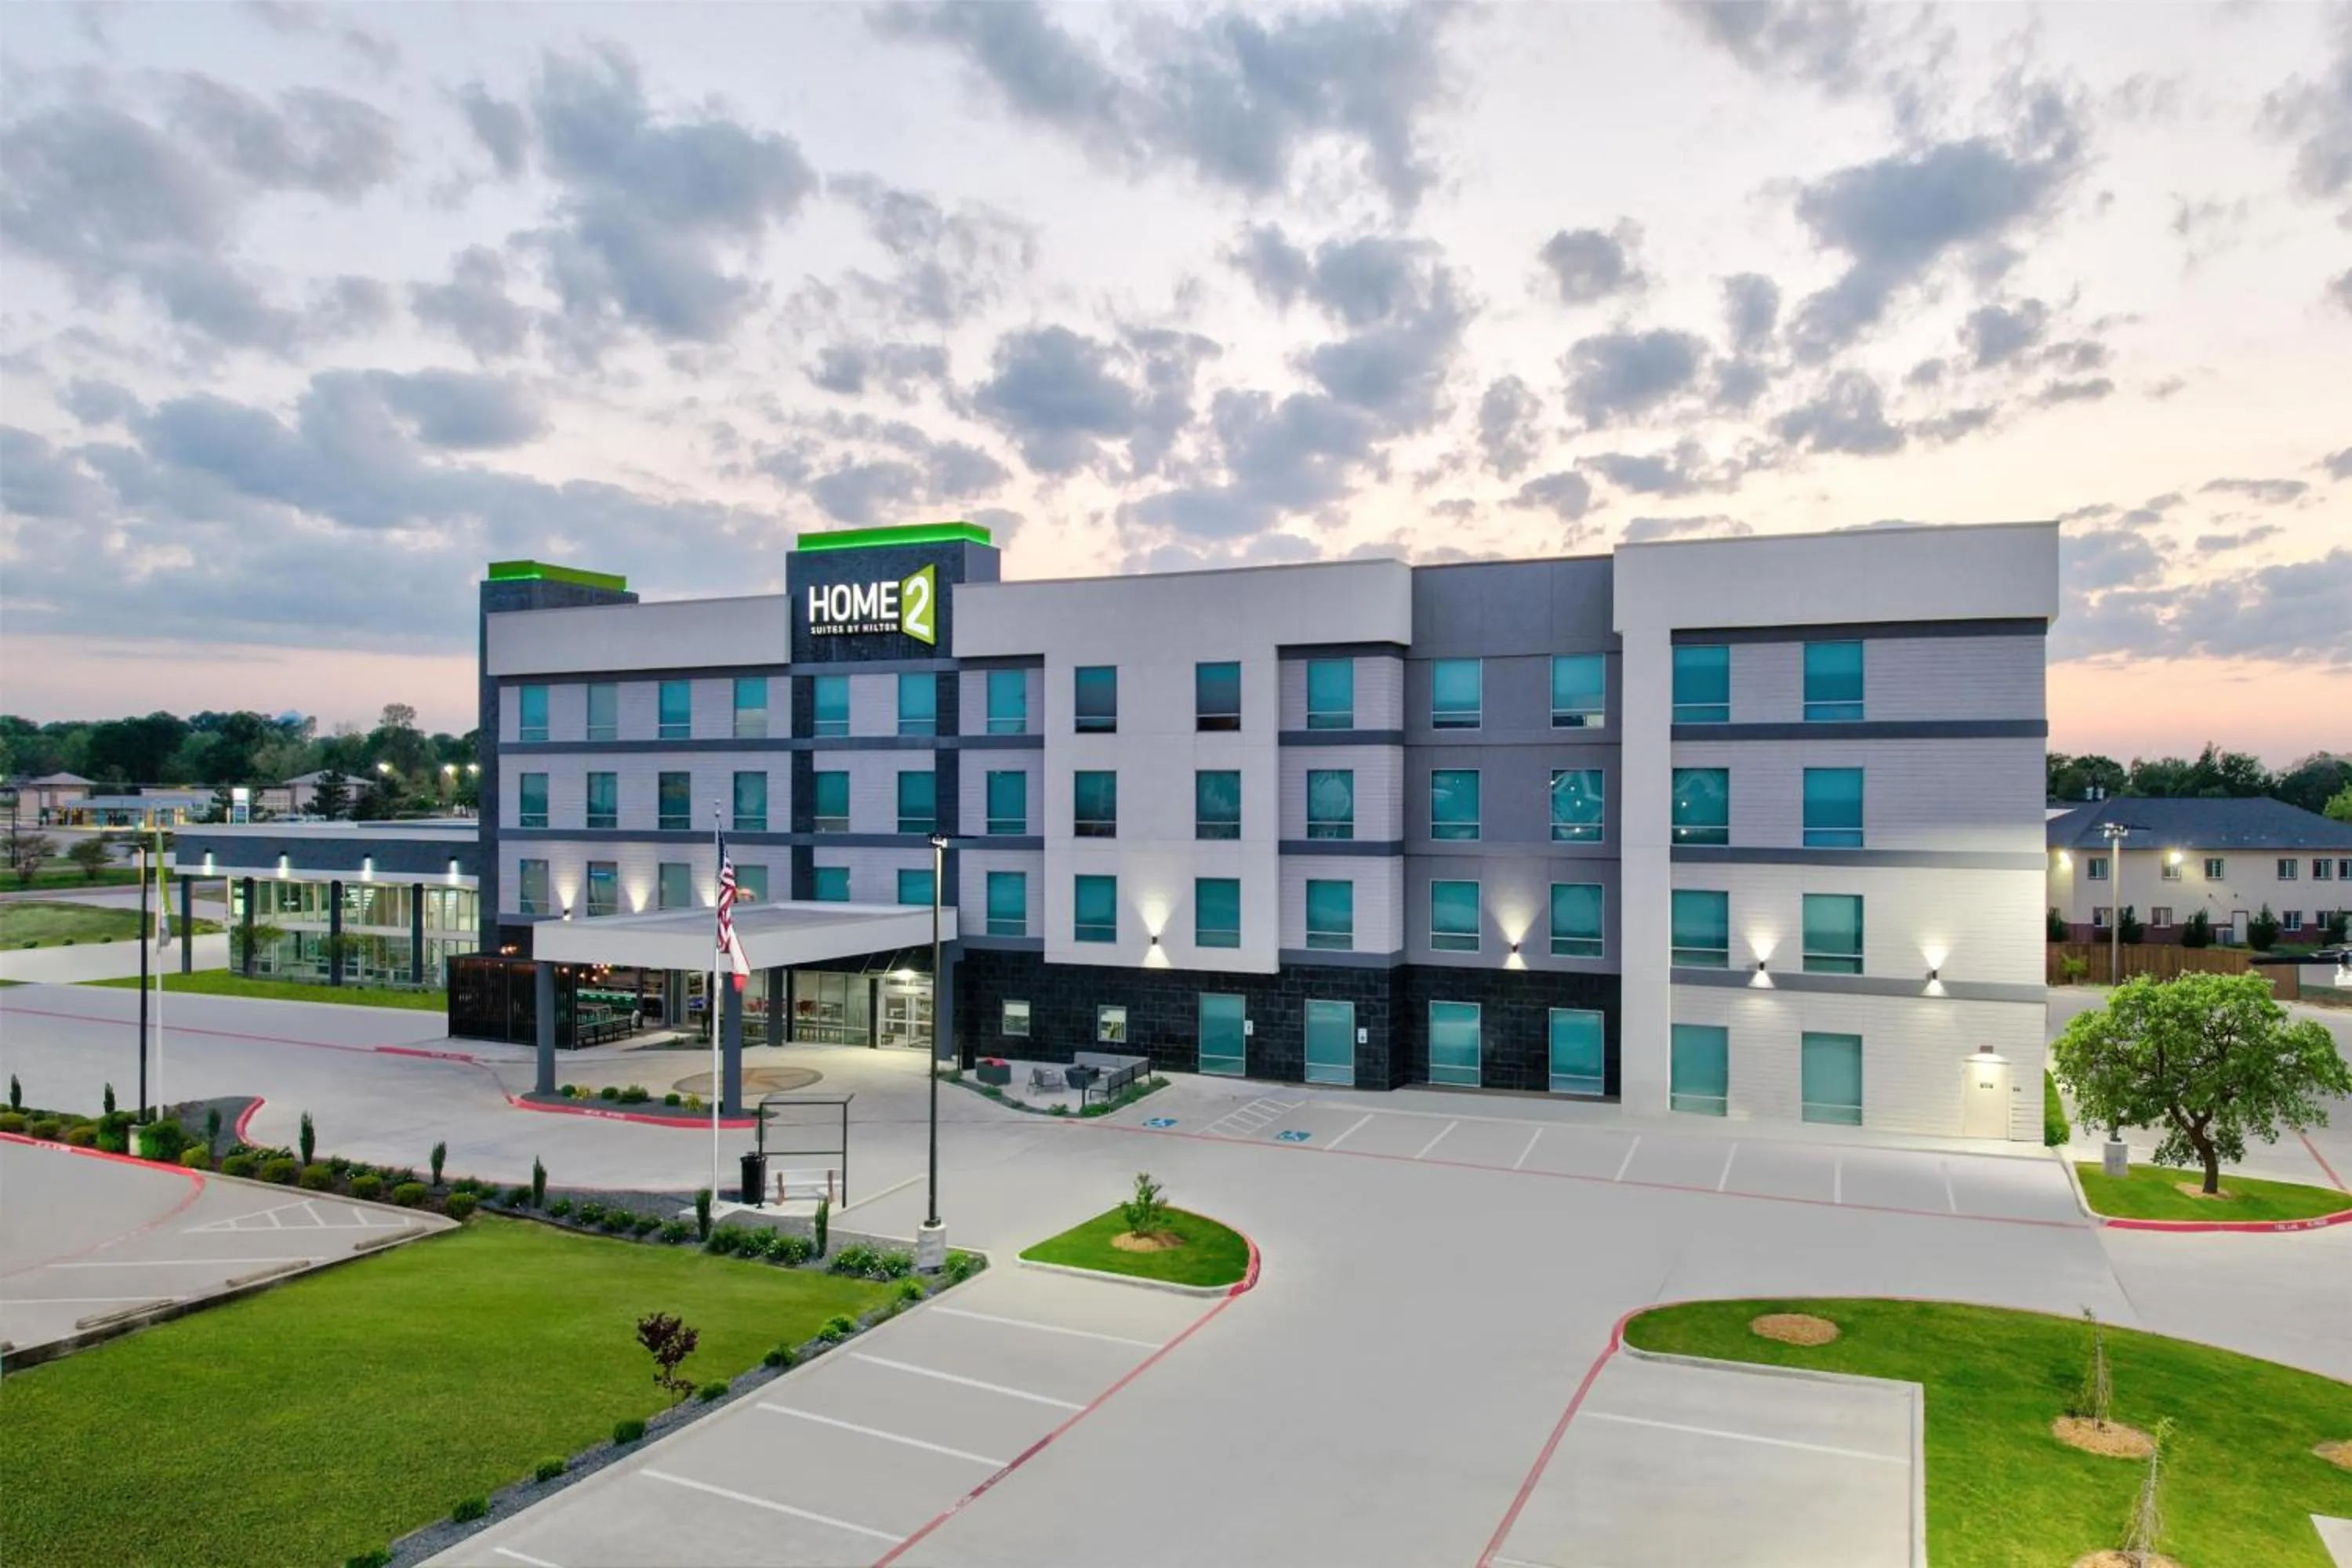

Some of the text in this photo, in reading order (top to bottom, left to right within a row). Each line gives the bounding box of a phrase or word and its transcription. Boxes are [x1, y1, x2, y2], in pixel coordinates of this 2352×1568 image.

[809, 576, 929, 636] HOME 2
[811, 622, 898, 635] SUITES BY HILTON
